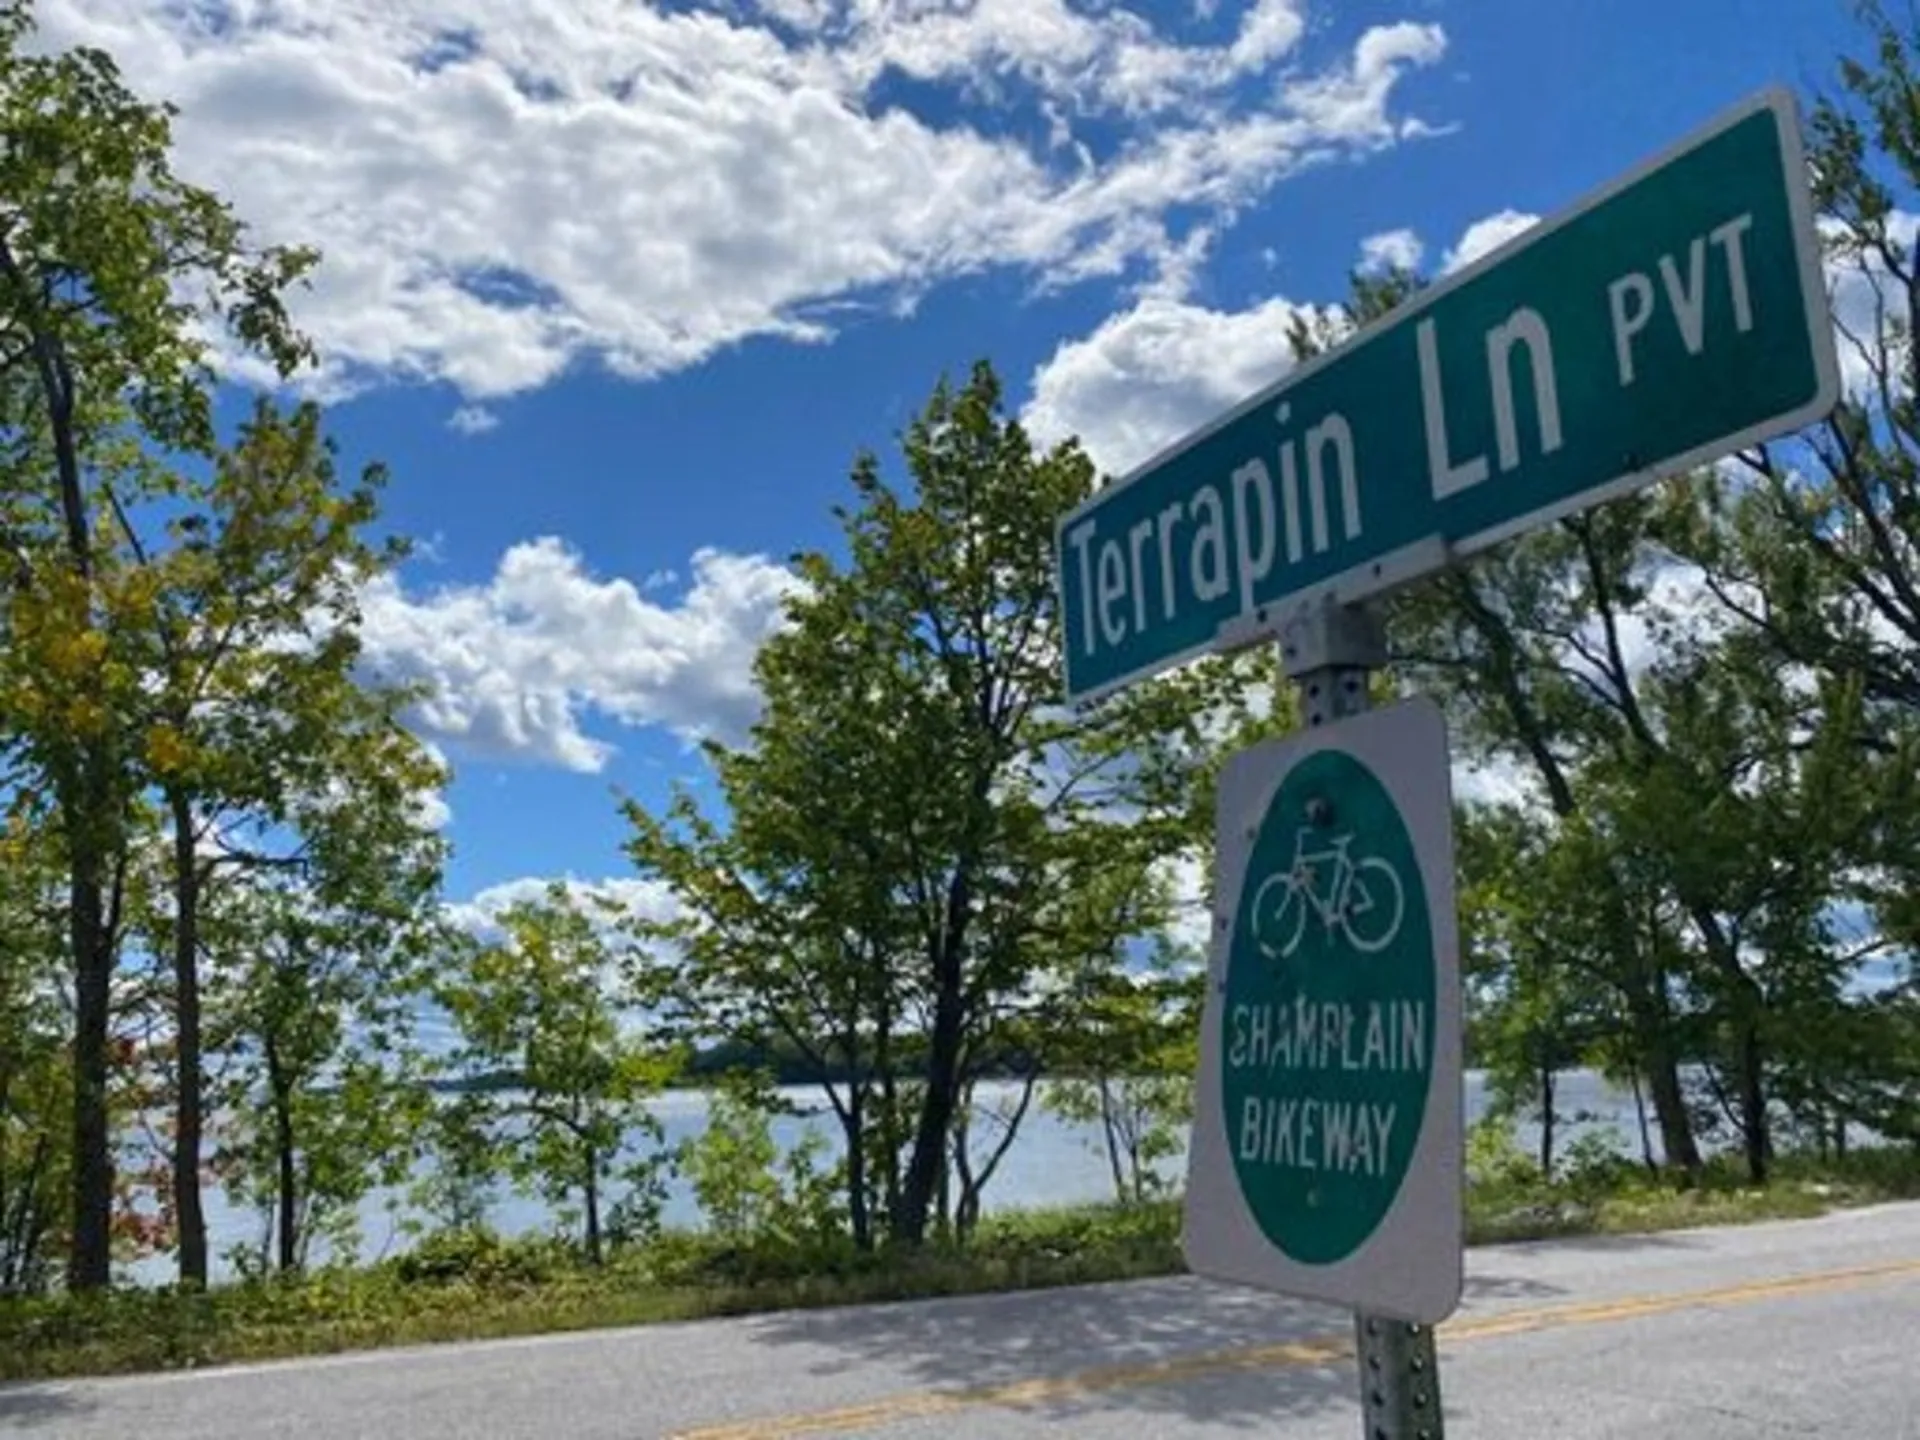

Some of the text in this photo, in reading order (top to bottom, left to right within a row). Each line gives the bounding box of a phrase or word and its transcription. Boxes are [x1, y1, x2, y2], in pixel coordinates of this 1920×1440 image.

[1070, 213, 1753, 657] Terrapin Ln PVT
[1240, 1096, 1398, 1177] BIKEWAY
